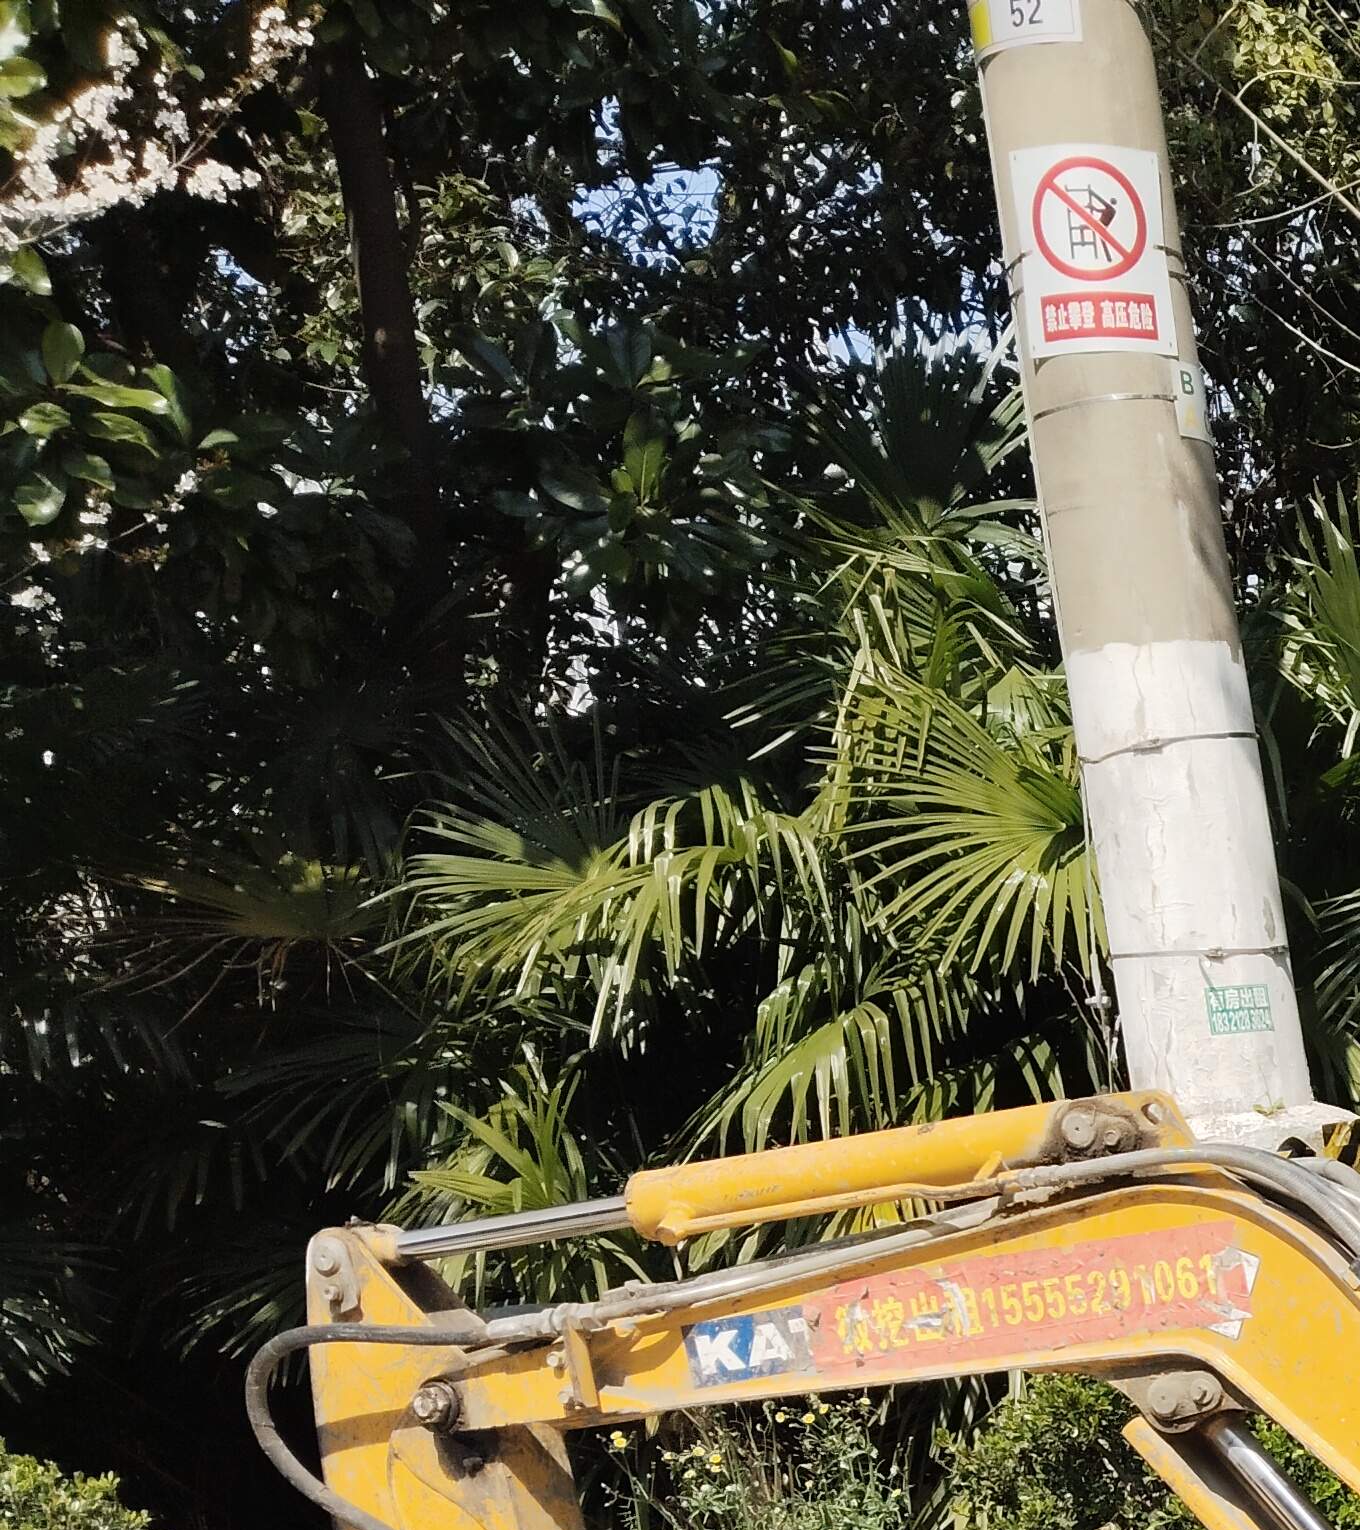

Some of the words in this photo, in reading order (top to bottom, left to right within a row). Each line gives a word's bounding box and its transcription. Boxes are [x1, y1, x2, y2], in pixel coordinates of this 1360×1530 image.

[1009, 0, 1043, 27] 52
[1100, 299, 1155, 331] 高压危险
[1180, 369, 1195, 395] B
